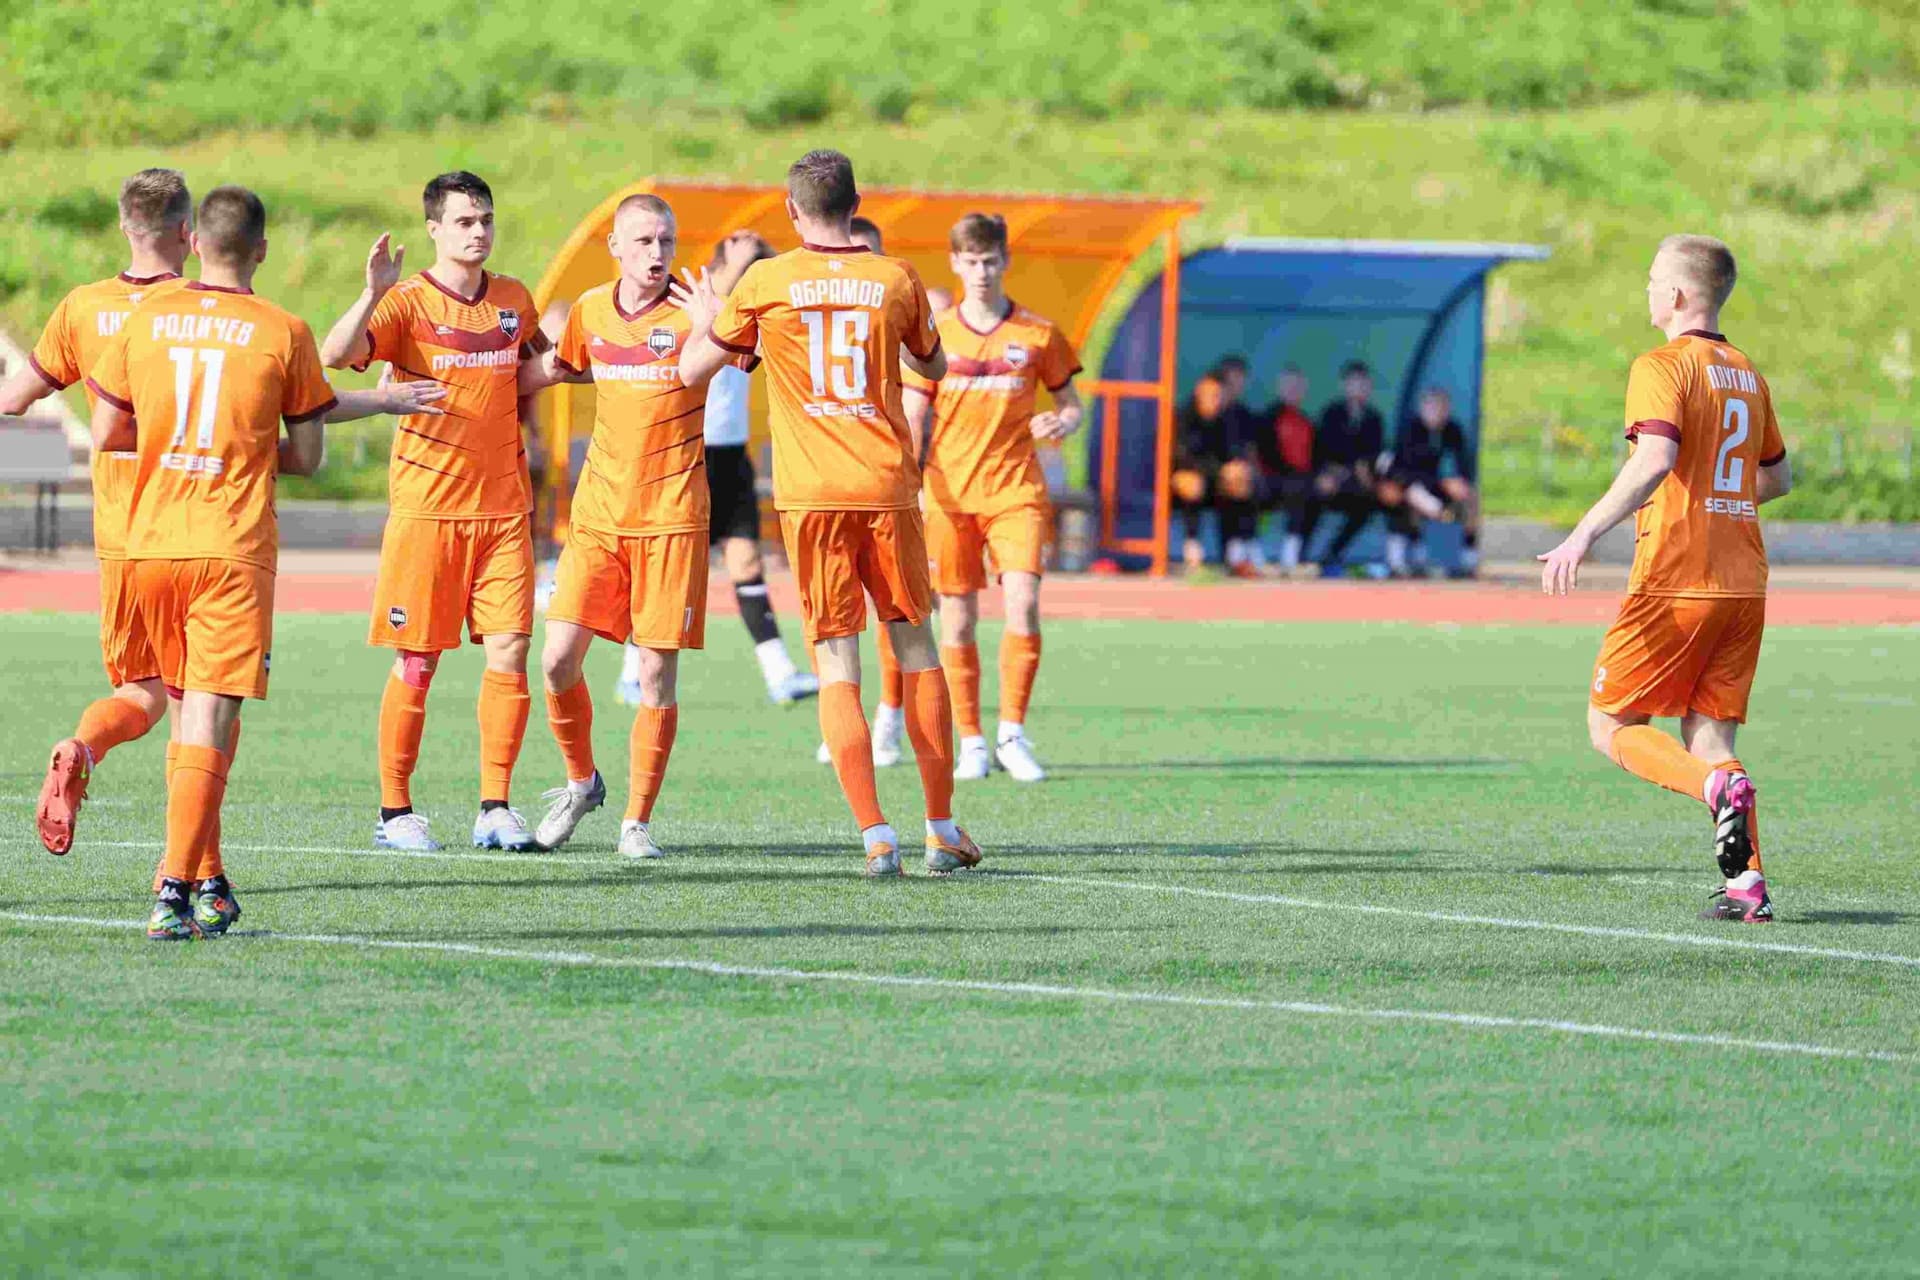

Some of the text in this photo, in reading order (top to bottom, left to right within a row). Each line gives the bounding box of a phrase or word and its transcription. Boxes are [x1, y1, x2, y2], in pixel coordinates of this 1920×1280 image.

[789, 278, 885, 309] АБРАМОВ
[152, 313, 254, 346] РОДИЧЕВ
[801, 311, 869, 399] 15
[169, 347, 225, 449] 11
[1714, 398, 1748, 492] 2
[1594, 667, 1606, 692] 2
